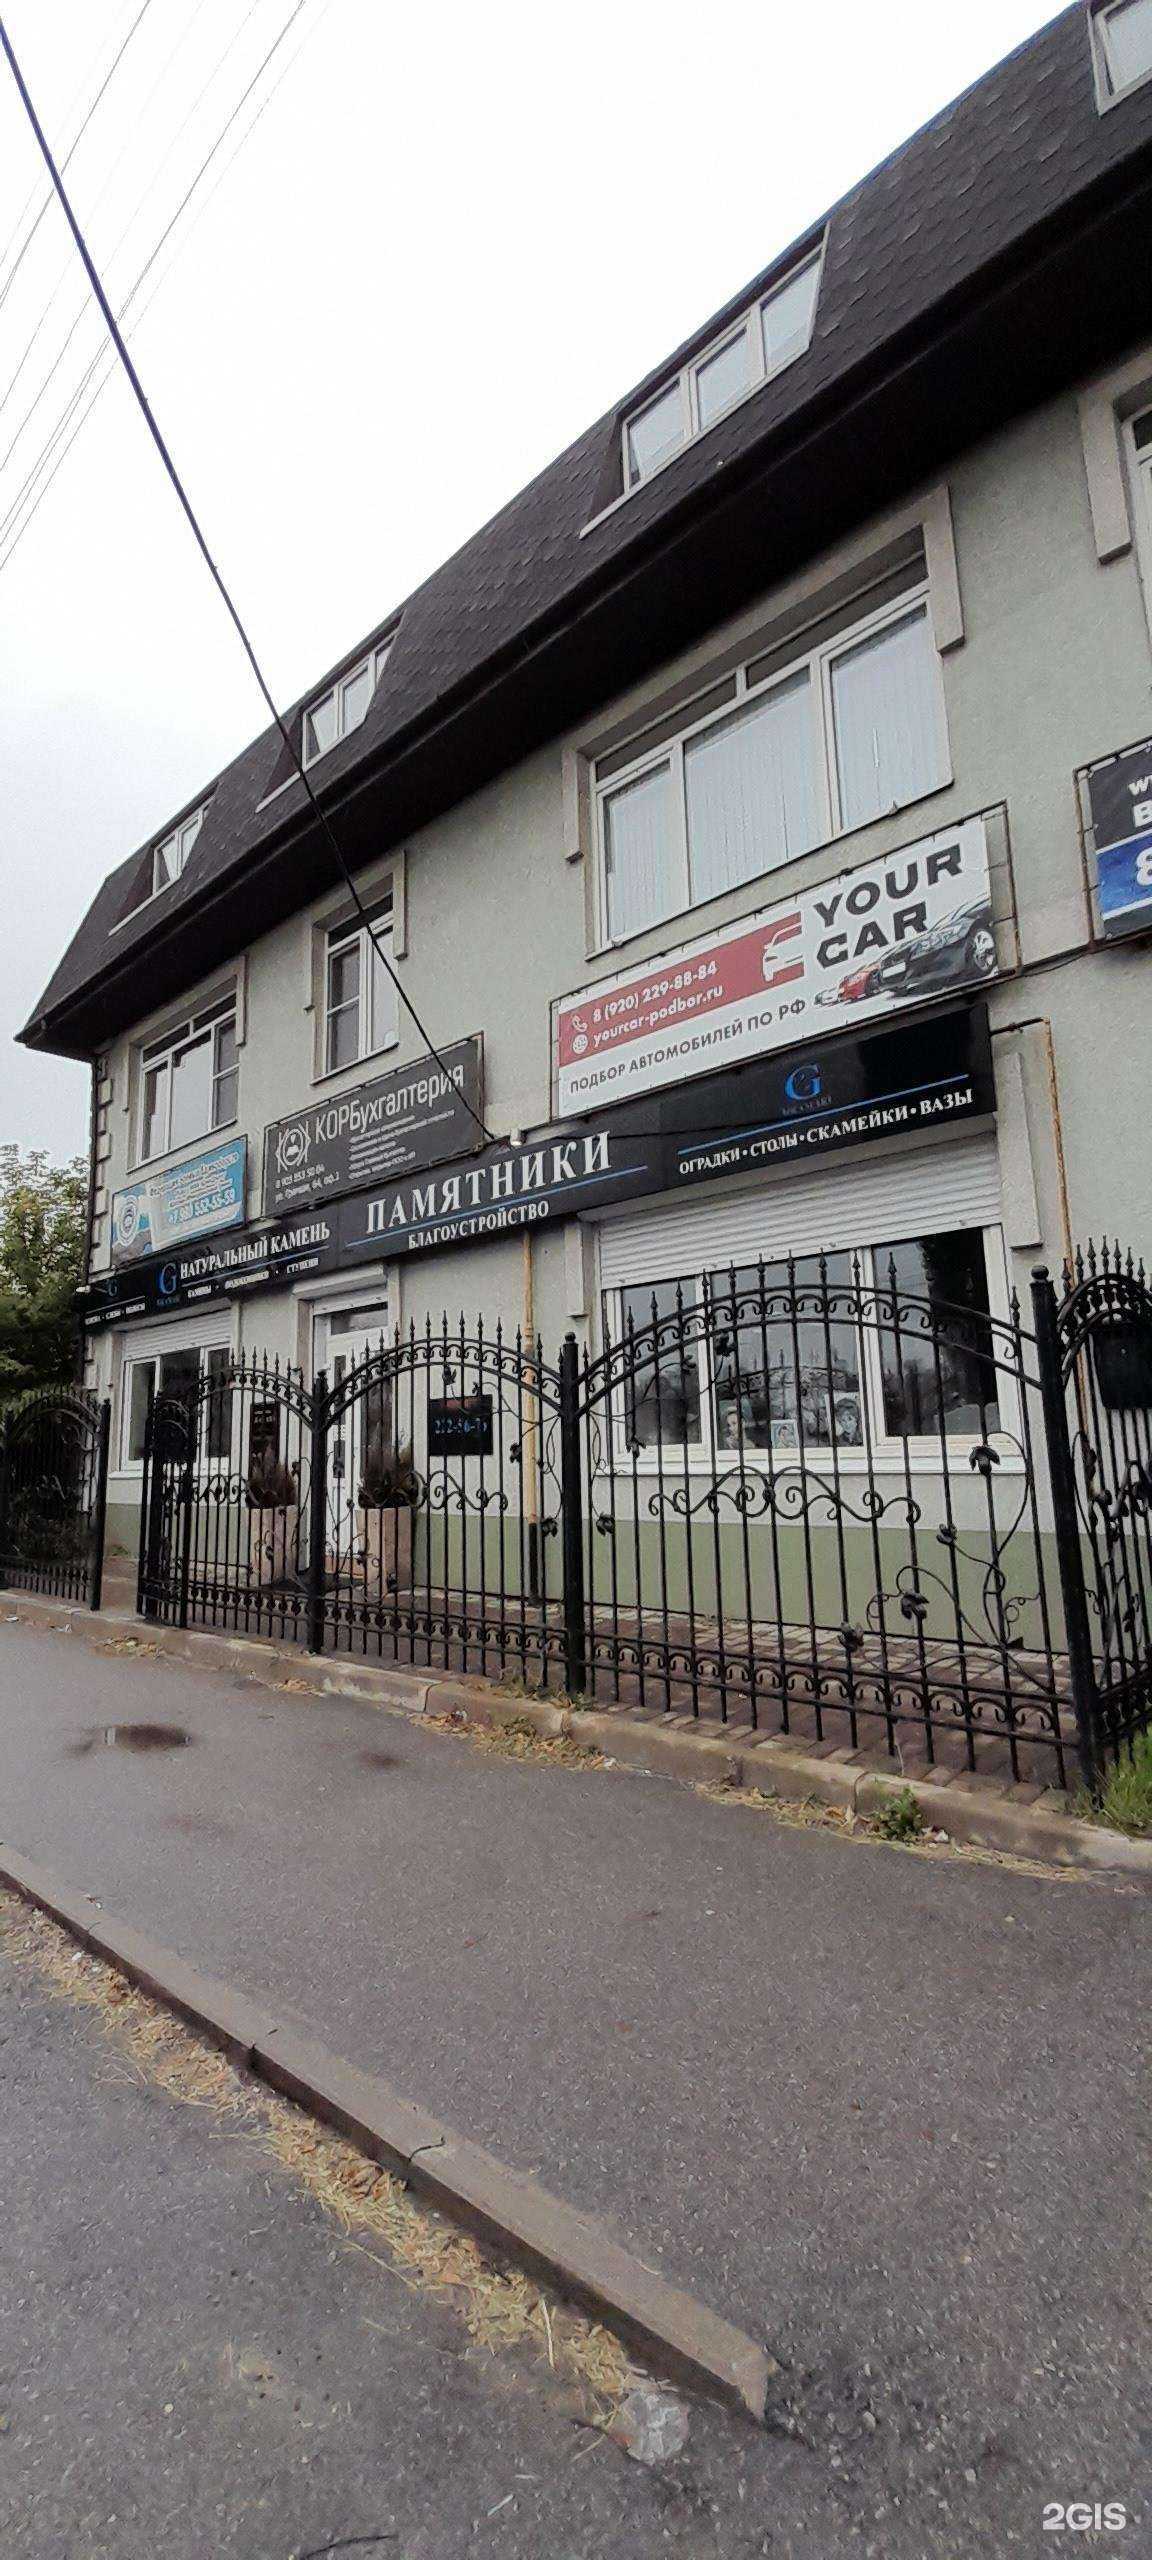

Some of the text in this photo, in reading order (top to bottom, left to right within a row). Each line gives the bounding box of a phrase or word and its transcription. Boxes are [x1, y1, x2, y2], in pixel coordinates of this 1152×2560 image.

[813, 842, 963, 927] YOUR
[815, 901, 927, 970] CAR
[592, 960, 718, 1024] 8 (920) 229-88-84
[592, 984, 724, 1048] yourcar-podbor.ru
[570, 998, 806, 1095] ПОДБОР АВТОМОБИЛЕЙ ПО РФ
[316, 1064, 465, 1144] КОРБухгалтерия
[679, 1147, 741, 1176] ОГРАДКИ
[750, 1132, 798, 1157] СТОЛЫ
[806, 1105, 909, 1143] СКАМЕЙКИ
[920, 1088, 973, 1116] ВАЗЫ
[365, 1131, 612, 1234] ПАМЯТНИКИ
[180, 1221, 331, 1280] НАТУРАЛЬНЫЙ КАМЕНЬ
[407, 1199, 550, 1250] БЛАГОУСТРОЙСТВО
